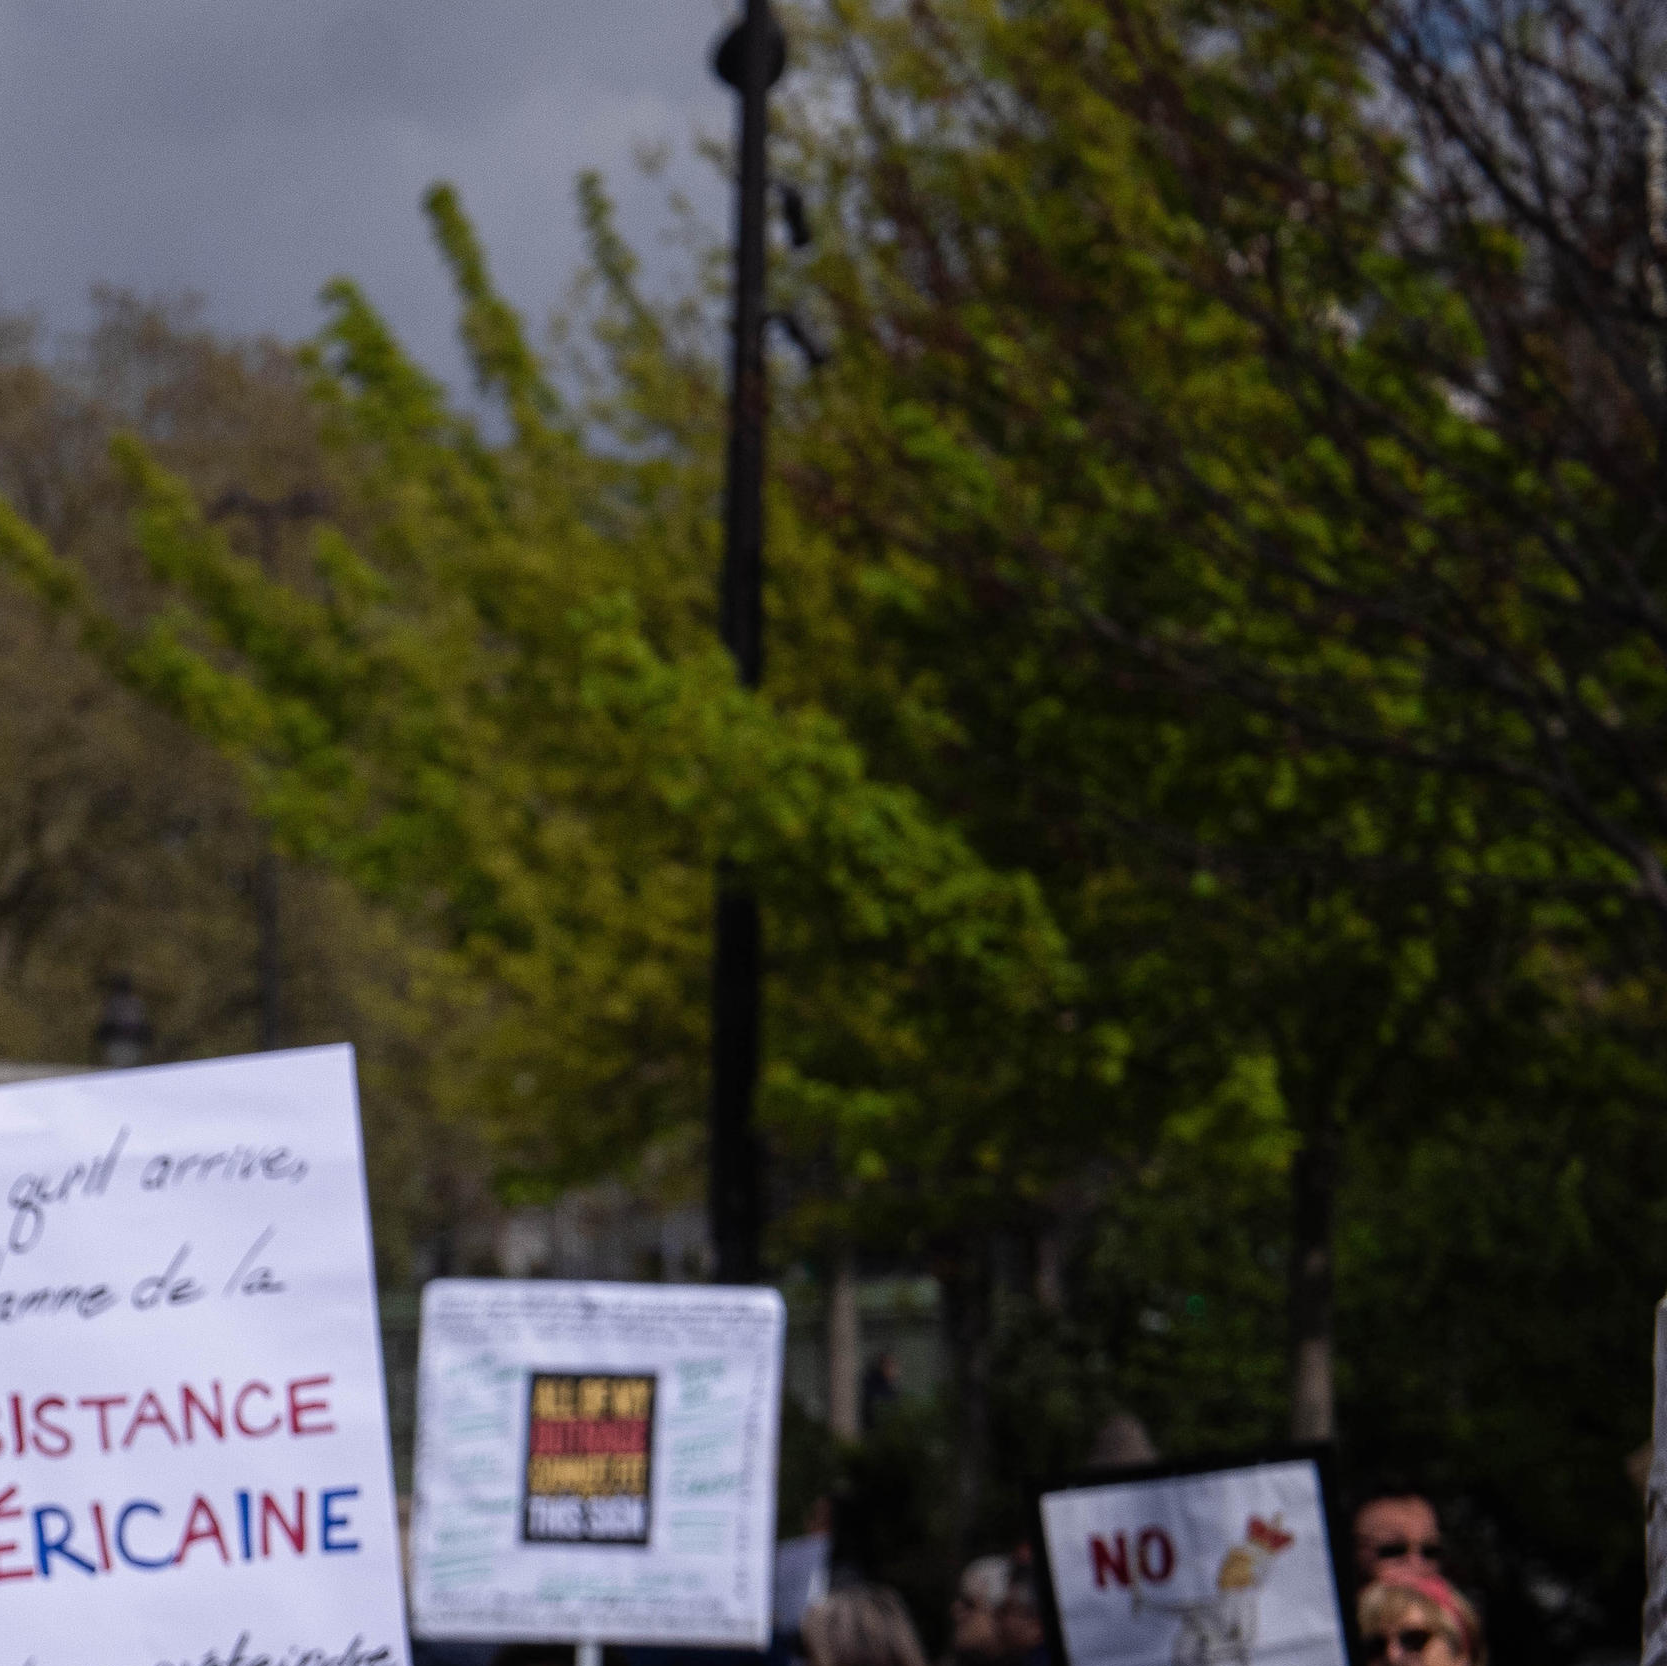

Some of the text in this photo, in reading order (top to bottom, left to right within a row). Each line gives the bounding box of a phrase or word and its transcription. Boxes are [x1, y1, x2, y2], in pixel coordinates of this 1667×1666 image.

[130, 1241, 204, 1312] de
[222, 1222, 287, 1297] la
[1088, 1526, 1175, 1590] NO
